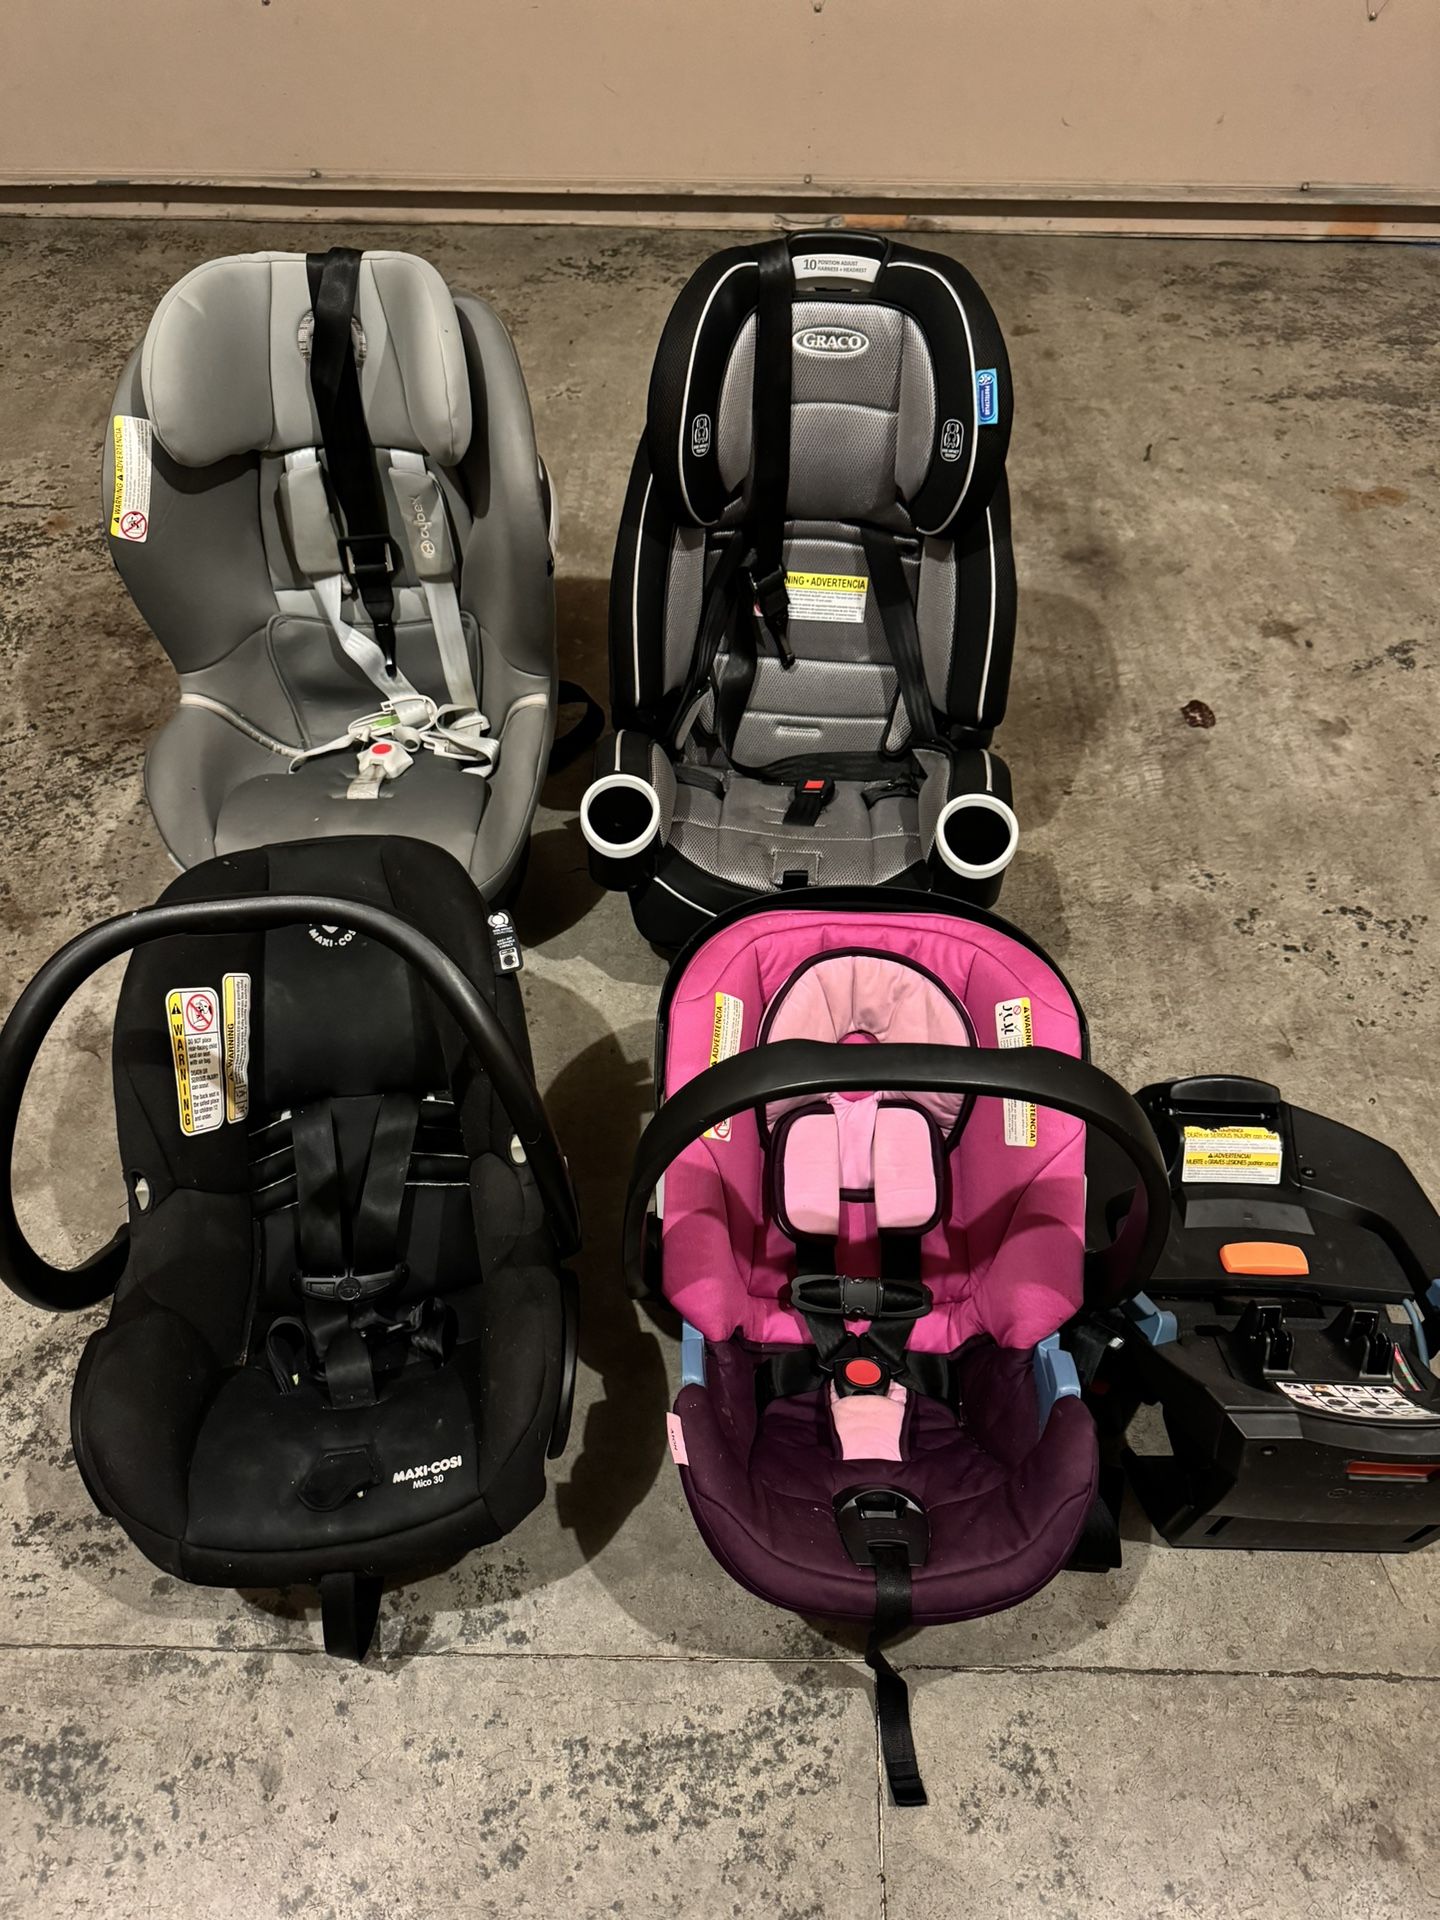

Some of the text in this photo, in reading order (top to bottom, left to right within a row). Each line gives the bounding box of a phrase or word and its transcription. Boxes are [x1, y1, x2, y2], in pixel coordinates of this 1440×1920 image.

[803, 259, 817, 271] 10
[803, 333, 862, 349] GRACO
[114, 427, 124, 515] WARNING ADVERTENCIA
[785, 575, 866, 589] NING ADVERTENCIA
[712, 1006, 723, 1059] ADVERTENCIA
[1023, 1011, 1032, 1047] WARNI
[174, 1023, 191, 1126] WARNING
[413, 1474, 444, 1489] Mico 30
